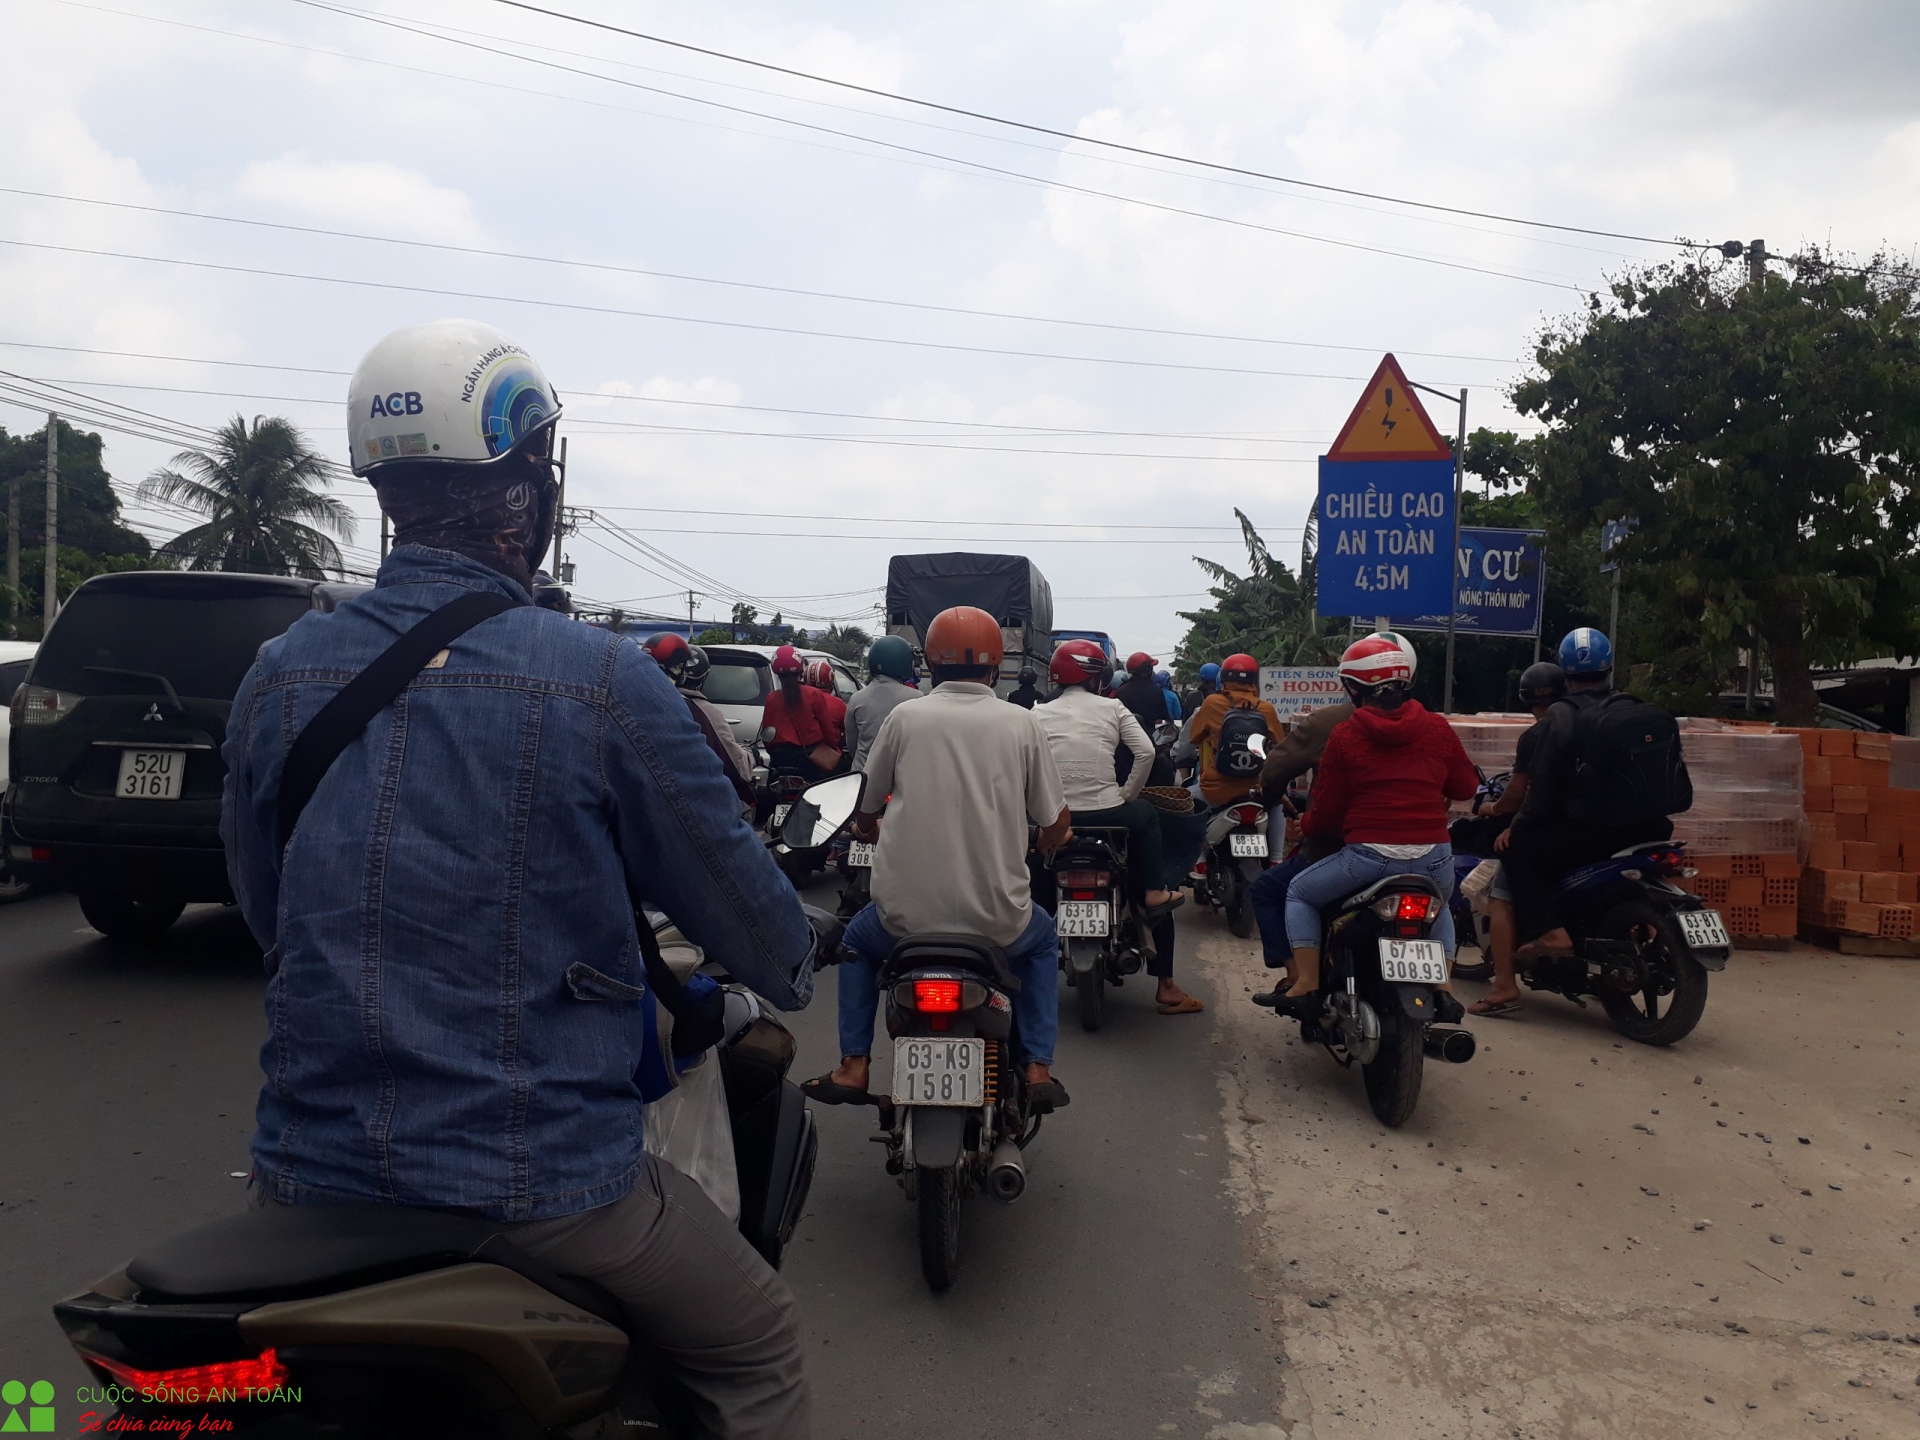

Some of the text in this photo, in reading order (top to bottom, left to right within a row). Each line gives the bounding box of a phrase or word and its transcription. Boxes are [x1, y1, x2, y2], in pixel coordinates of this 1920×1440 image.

[461, 368, 482, 403] NGÂN
[477, 348, 503, 370] HÀNG
[370, 391, 424, 419] ACB
[1326, 482, 1444, 519] CHIỀU CAO
[1336, 523, 1434, 555] AN TOÀN
[1482, 546, 1525, 581] CƯ
[1355, 565, 1409, 592] 4,5M
[1459, 586, 1482, 606] NÔNG
[1484, 588, 1507, 608] THÔN
[1307, 669, 1334, 679] SƠN
[134, 754, 171, 774] 52U
[125, 775, 171, 796] 3161
[850, 853, 875, 865] 308.
[1066, 903, 1100, 918] 63-B1
[1685, 913, 1717, 928] 63-B1
[1060, 920, 1106, 935] 421.53
[1687, 928, 1728, 946] 661.91
[1390, 941, 1433, 961] 67-H1
[1386, 961, 1443, 981] 308.93
[907, 1044, 970, 1070] 63-K9
[907, 1073, 967, 1101] 1581
